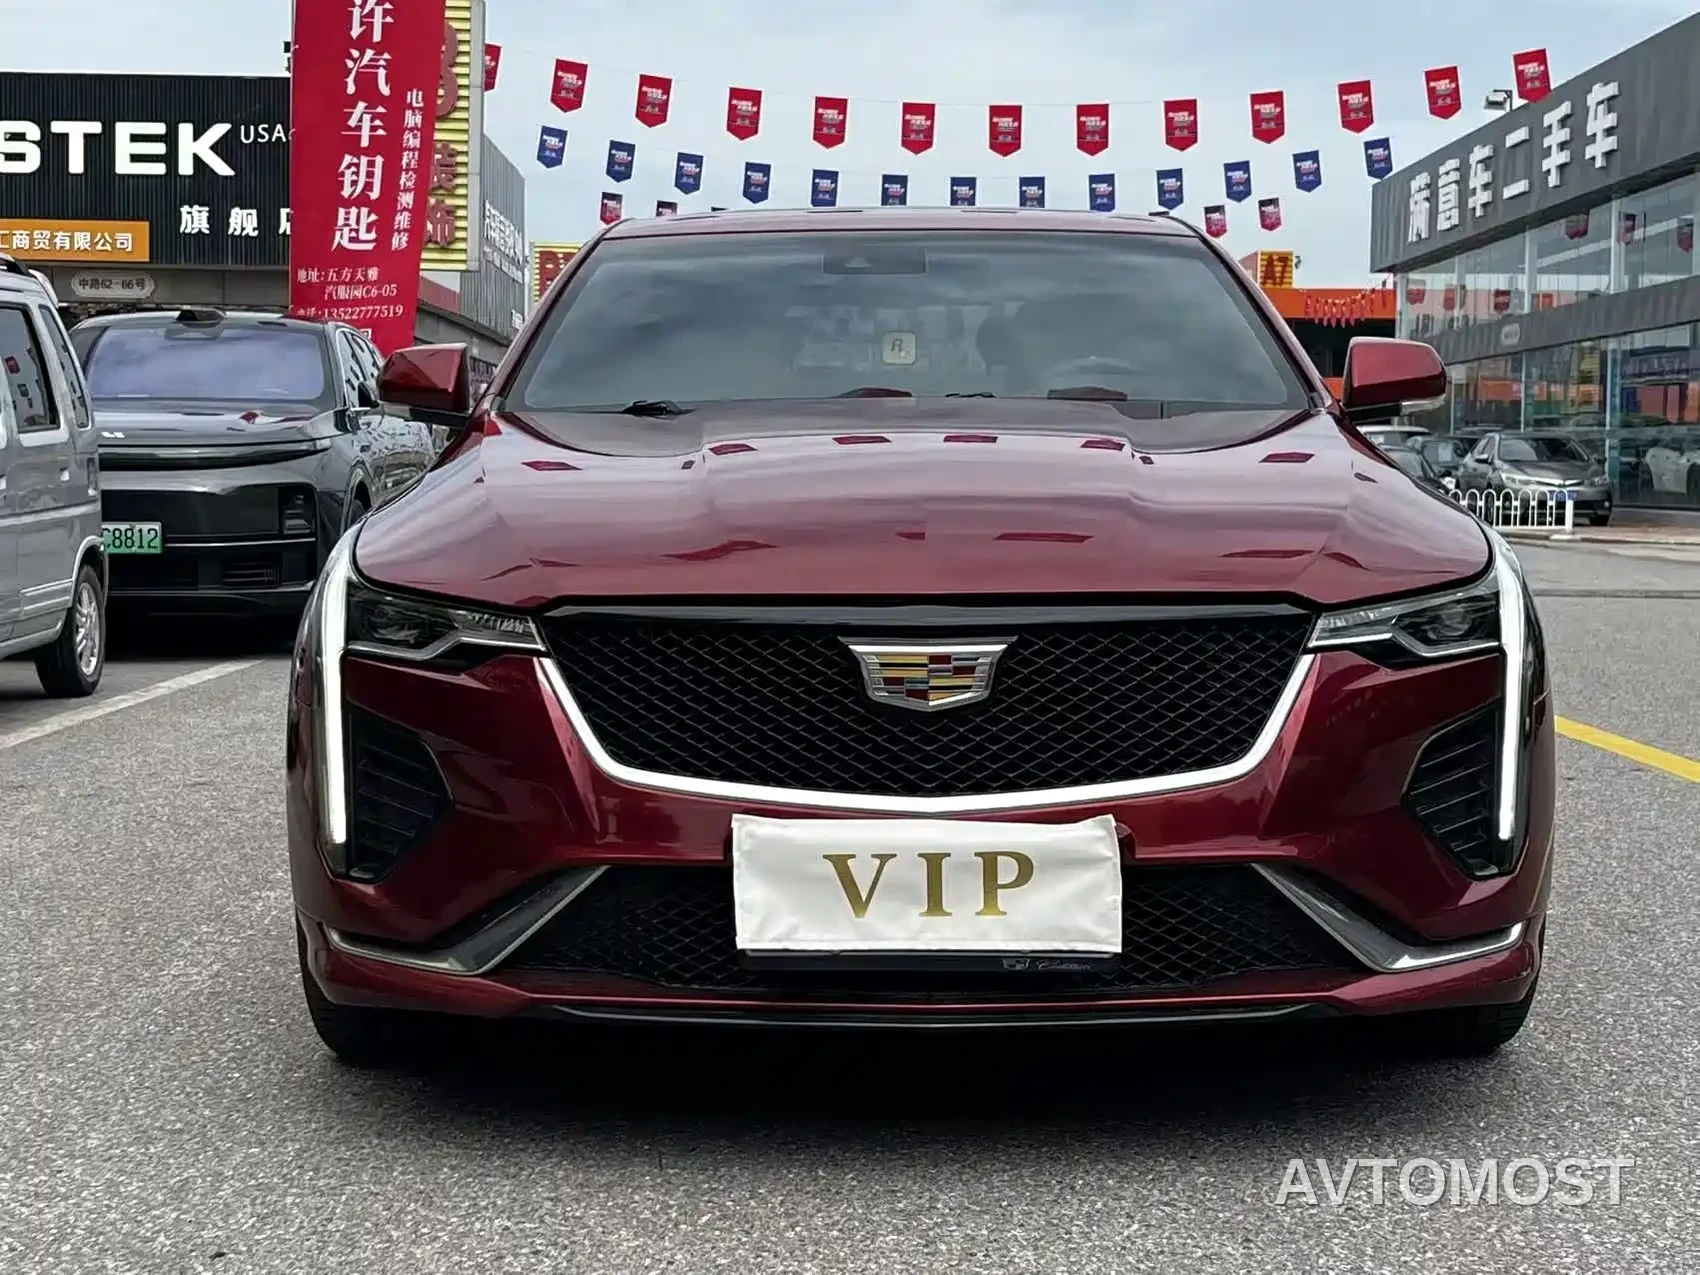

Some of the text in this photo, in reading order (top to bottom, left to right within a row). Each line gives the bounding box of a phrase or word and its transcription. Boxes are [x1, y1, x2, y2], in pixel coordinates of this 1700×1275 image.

[0, 120, 286, 176] STEK USA
[330, 0, 395, 252] 许汽车钥匙
[391, 88, 424, 251] 电脑编程检测维修
[823, 851, 1034, 919] VIP
